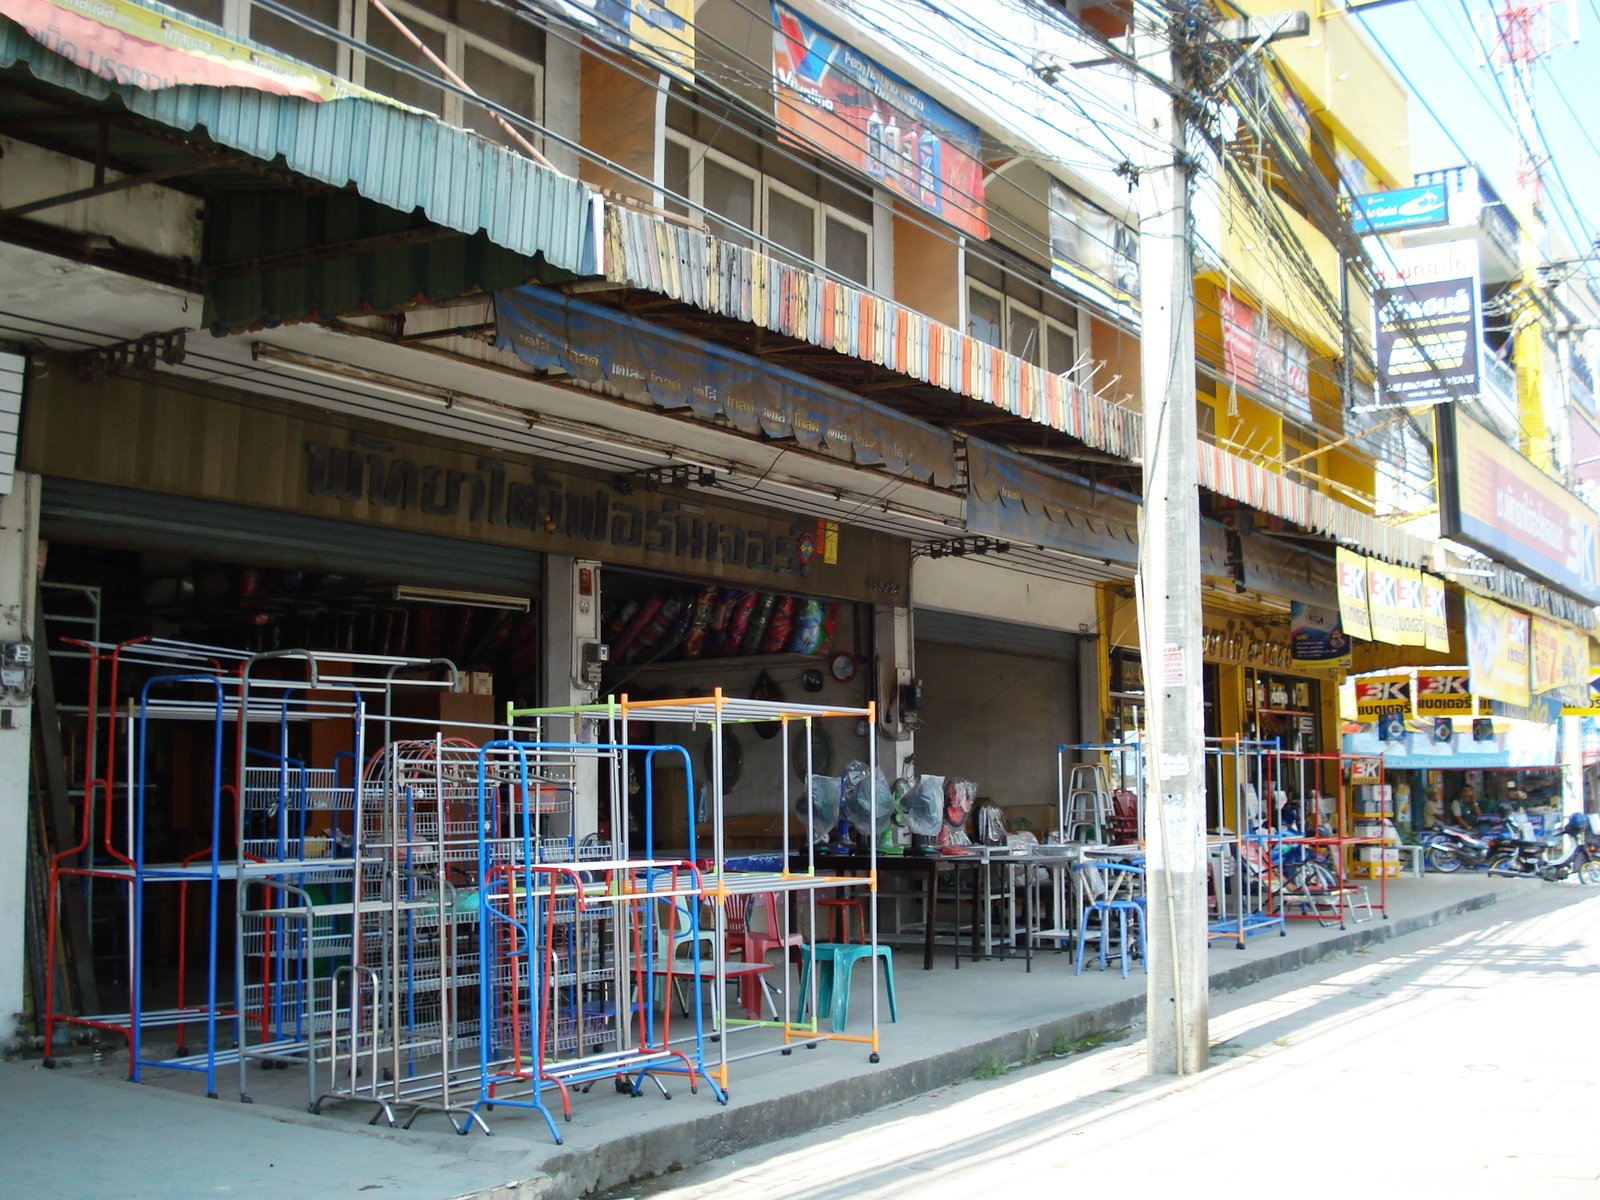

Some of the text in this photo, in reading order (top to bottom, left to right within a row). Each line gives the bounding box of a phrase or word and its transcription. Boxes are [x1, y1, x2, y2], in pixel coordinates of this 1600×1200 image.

[1340, 563, 1366, 601] 3K
[1371, 572, 1396, 607] 3K
[1397, 579, 1422, 610] 3K
[1425, 587, 1444, 617] 3K
[1360, 682, 1408, 701] 3K
[1422, 676, 1469, 694] 3K
[1354, 764, 1378, 777] 3K
